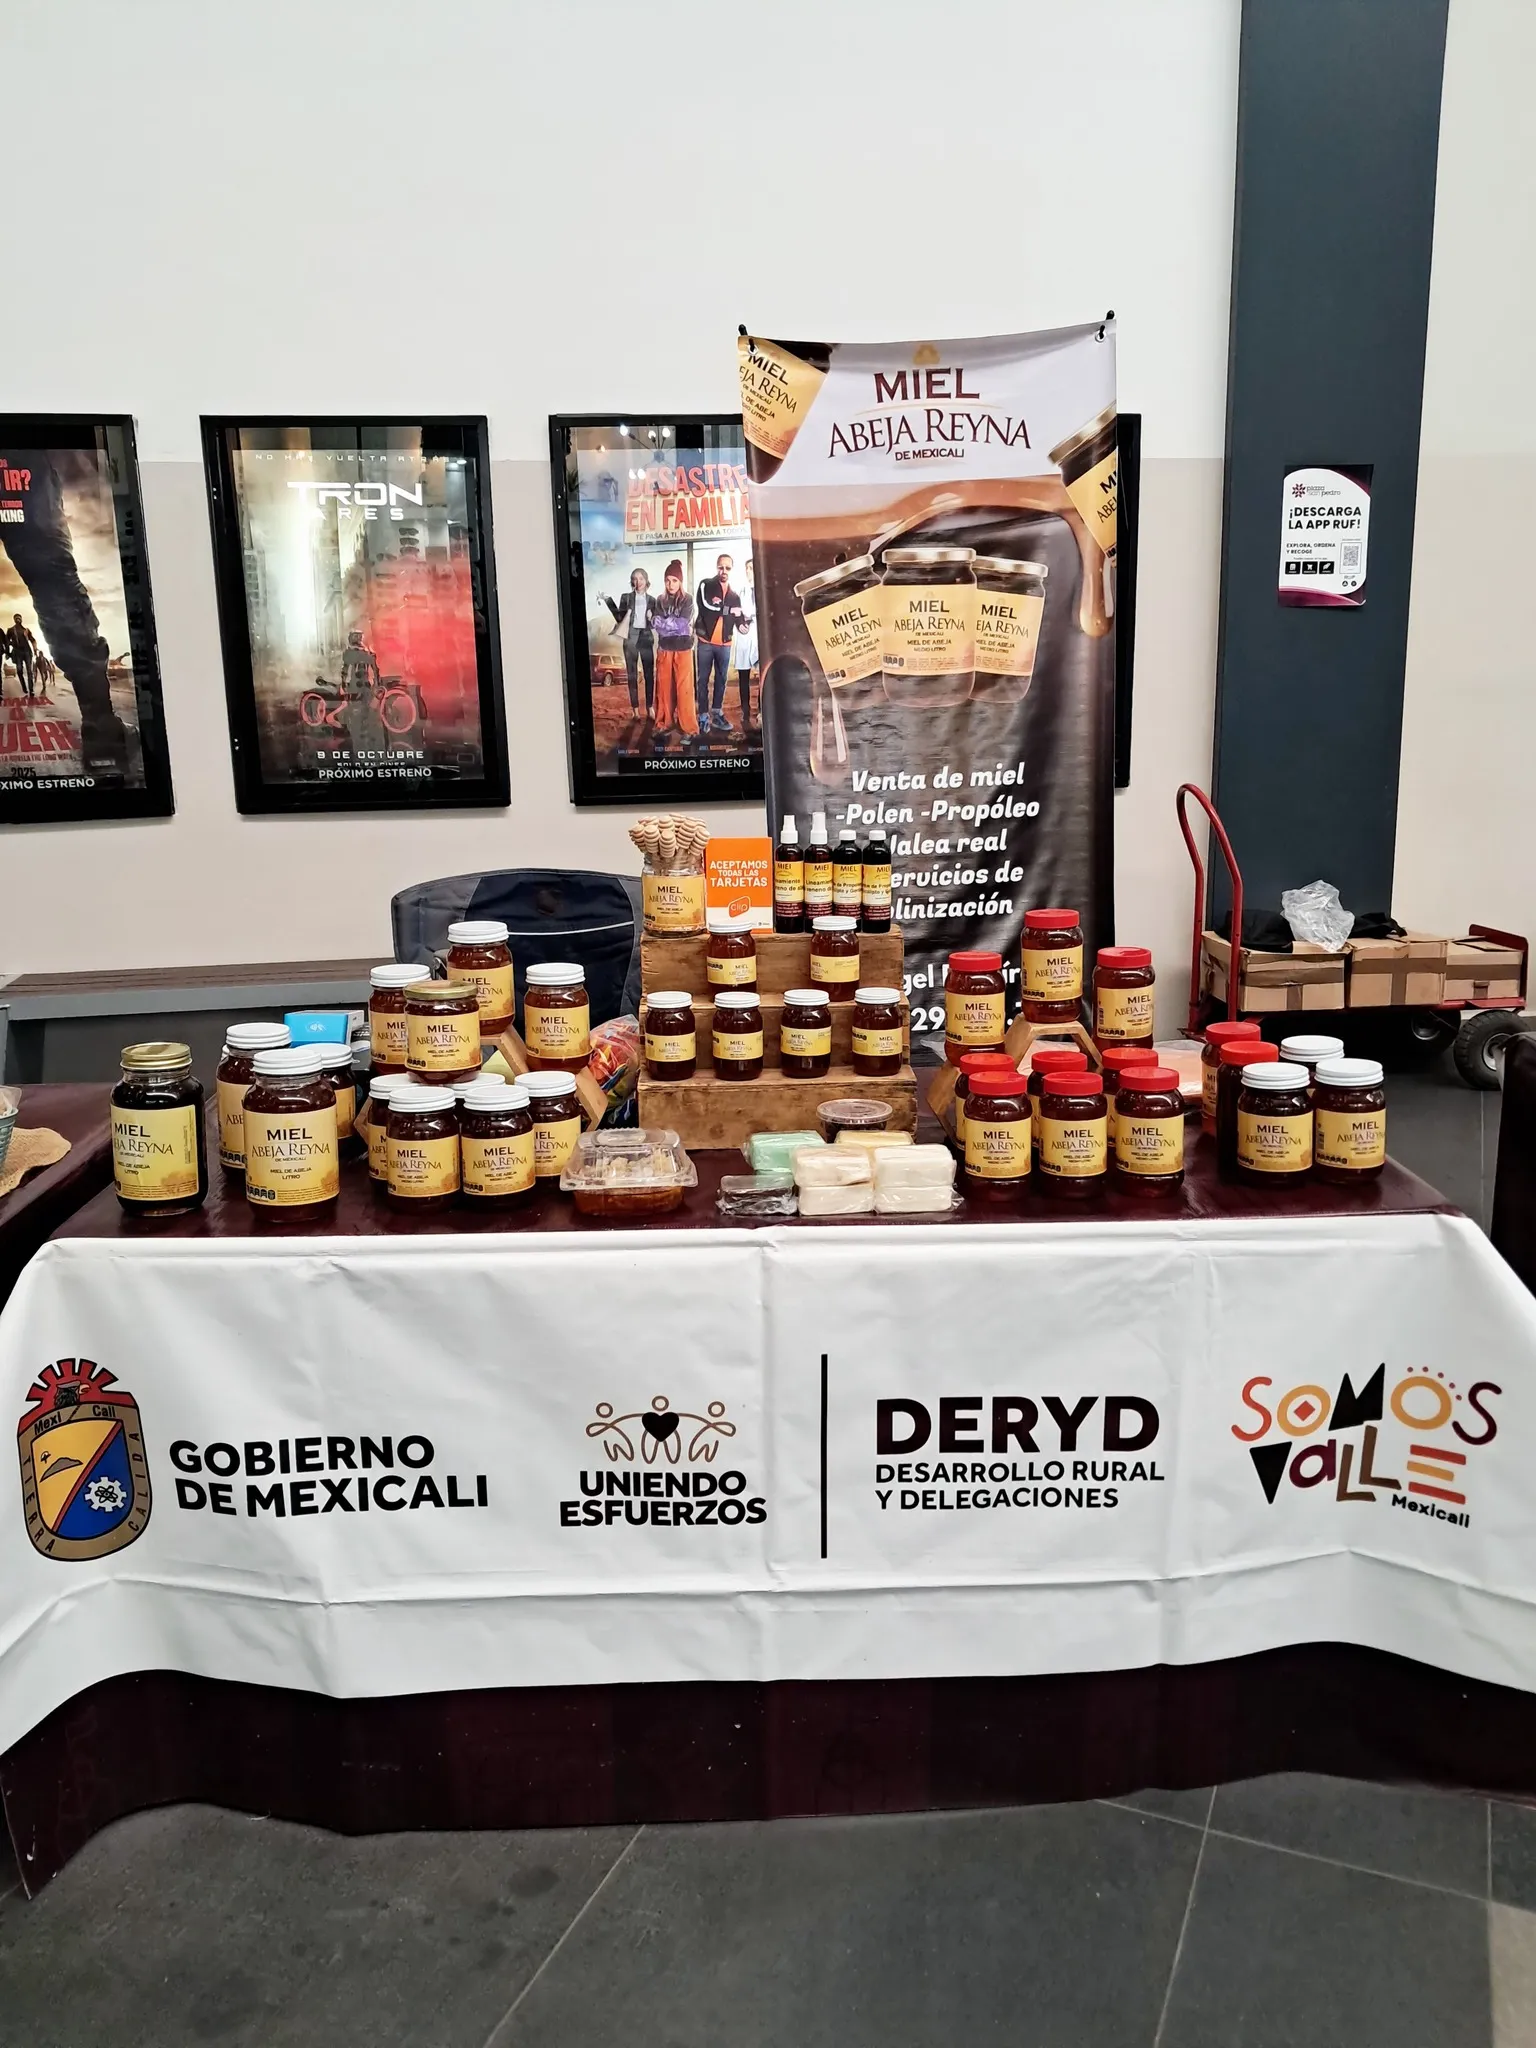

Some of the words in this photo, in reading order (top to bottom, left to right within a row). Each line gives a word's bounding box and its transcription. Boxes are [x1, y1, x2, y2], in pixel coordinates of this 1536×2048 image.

[748, 355, 788, 385] MIEL
[874, 367, 980, 403] MIEL
[758, 377, 797, 413] REYNA
[828, 415, 918, 458] ABEJA
[924, 408, 1031, 449] REYNA
[895, 451, 910, 460] DE
[912, 448, 964, 459] MEXICALI
[4, 469, 31, 491] IR?
[287, 482, 423, 506] TRON
[0, 509, 25, 522] KING
[626, 500, 656, 531] EN
[1288, 520, 1303, 530] LA
[1306, 520, 1331, 530] APP
[909, 600, 950, 613] MIEL
[981, 604, 1017, 619] MIEL
[832, 607, 868, 629] MIEL
[894, 619, 924, 633] ABEJA
[928, 616, 965, 632] REYNA
[825, 631, 852, 651] ABEJA
[316, 751, 326, 759] 9
[332, 751, 351, 759] DE
[357, 750, 425, 759] OCTUBRE
[644, 758, 697, 770] PRÓXIMO
[699, 758, 751, 769] ESTRENO
[319, 766, 374, 779] PRÓXIMO
[377, 767, 432, 778] ESTRENO
[851, 769, 927, 792] Venta
[933, 766, 964, 789] de
[969, 761, 1025, 787] miel
[37, 778, 95, 789] ESTRENO
[836, 801, 914, 825] -Polen
[920, 794, 1041, 827] -Propóleo
[956, 828, 1008, 853] real
[709, 860, 768, 870] ACEPTAMOS
[995, 859, 1024, 883] de
[718, 869, 742, 877] TODAS
[743, 869, 759, 877] LAS
[709, 877, 768, 887] TARJETAS
[1047, 957, 1074, 967] MIEL
[1035, 968, 1059, 978] ABEJA
[1127, 994, 1151, 1005] MIEL
[965, 1002, 993, 1011] MIEL
[540, 1016, 569, 1025] MIEL
[427, 1024, 458, 1033] MIEL
[416, 1036, 439, 1045] ABEJA
[114, 1122, 151, 1138] MIEL
[1131, 1126, 1163, 1136] MIEL
[1256, 1124, 1289, 1134] MIEL
[1352, 1121, 1379, 1131] MIEL
[267, 1127, 313, 1141] MIEL
[983, 1131, 1014, 1139] MIEL
[1063, 1129, 1094, 1138] MIEL
[128, 1138, 174, 1155] REYNA
[251, 1145, 285, 1159] ABEJA
[289, 1142, 331, 1157] REYNA
[484, 1146, 515, 1157] MIEL
[539, 1141, 569, 1150] REYNA
[1051, 1140, 1077, 1150] ABEJA
[397, 1149, 427, 1158] MIEL
[410, 1160, 442, 1170] REYNA
[472, 1159, 498, 1170] ABEJA
[876, 1395, 1160, 1455] DERYD
[169, 1435, 435, 1477] GOBIERNO
[875, 1460, 1065, 1483] DESARROLLO
[1072, 1460, 1165, 1481] RURAL
[127, 1432, 148, 1532] CALIDA
[579, 1470, 747, 1498] UNIENDO
[175, 1477, 238, 1517] DE
[247, 1474, 488, 1518] MEXICALI
[874, 1490, 893, 1510] Y
[900, 1487, 1119, 1510] DELEGACIONES
[23, 1455, 56, 1553] TIERRA
[559, 1497, 768, 1527] ESFUERZOS
[1391, 1493, 1470, 1529] Mexicali
